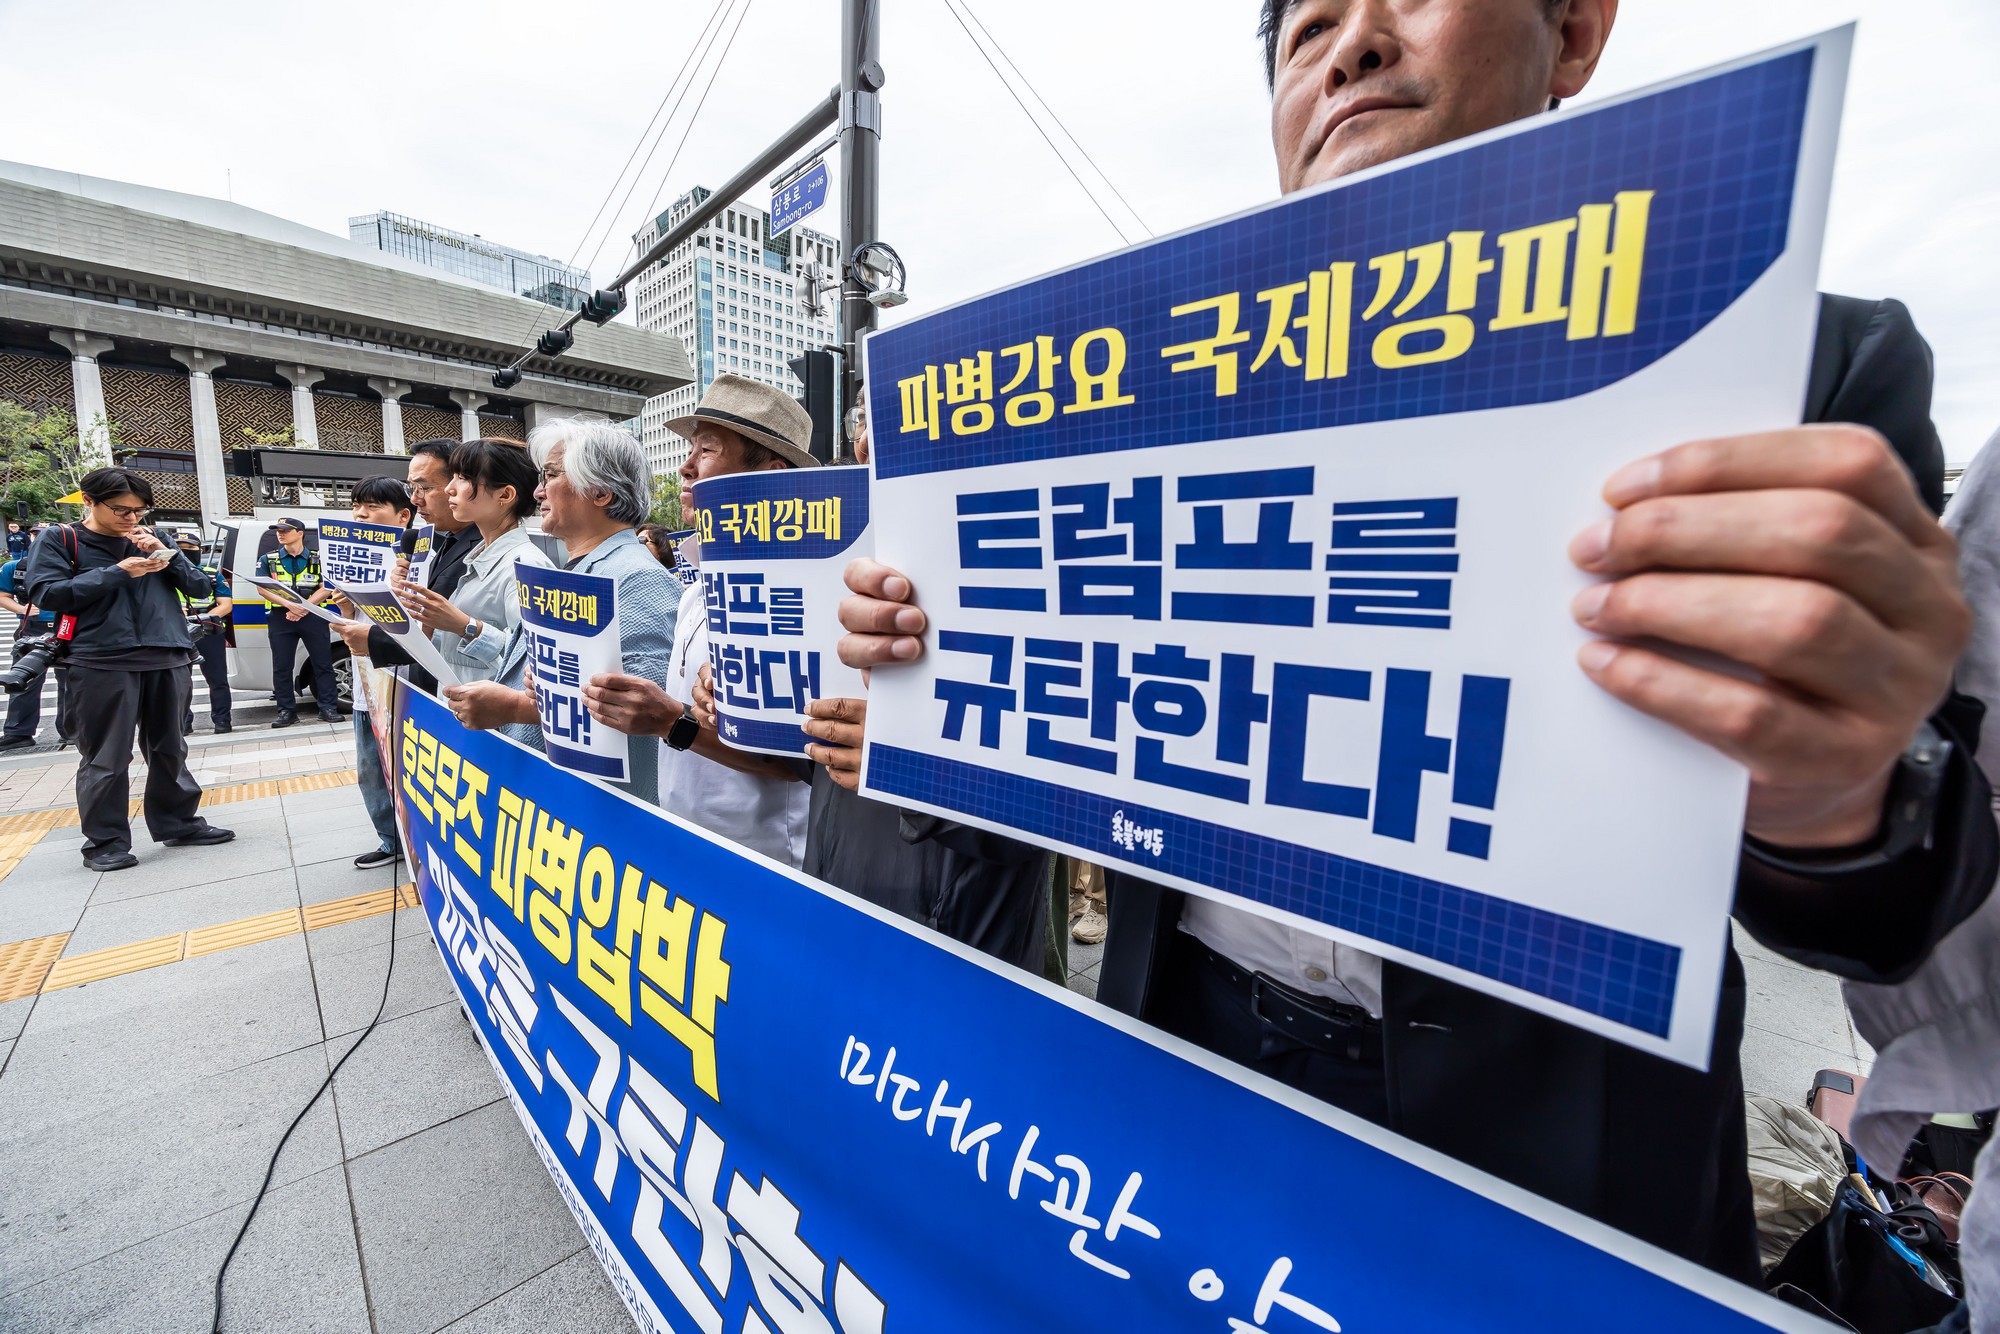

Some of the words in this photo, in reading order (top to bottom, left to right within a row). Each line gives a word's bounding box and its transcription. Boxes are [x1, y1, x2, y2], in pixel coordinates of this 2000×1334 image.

[773, 185, 801, 217] 삼봉로
[773, 200, 813, 232] Sambong-ro
[897, 326, 1136, 442] 파병강요
[1160, 190, 1655, 397] 국제깡패
[351, 528, 396, 543] 국제깡패
[719, 496, 842, 544] 국제깡패
[327, 543, 383, 567] 트럼프를
[955, 465, 1460, 630] 트럼프를
[532, 585, 598, 627] 국제깡패
[933, 629, 1512, 861] 규탄한다!
[1112, 810, 1164, 857] 촛불행동
[402, 716, 490, 880] 호르무즈
[490, 785, 733, 1106] 파병압박
[426, 840, 544, 1097] 미국을
[839, 1034, 1162, 1280] 미대사관
